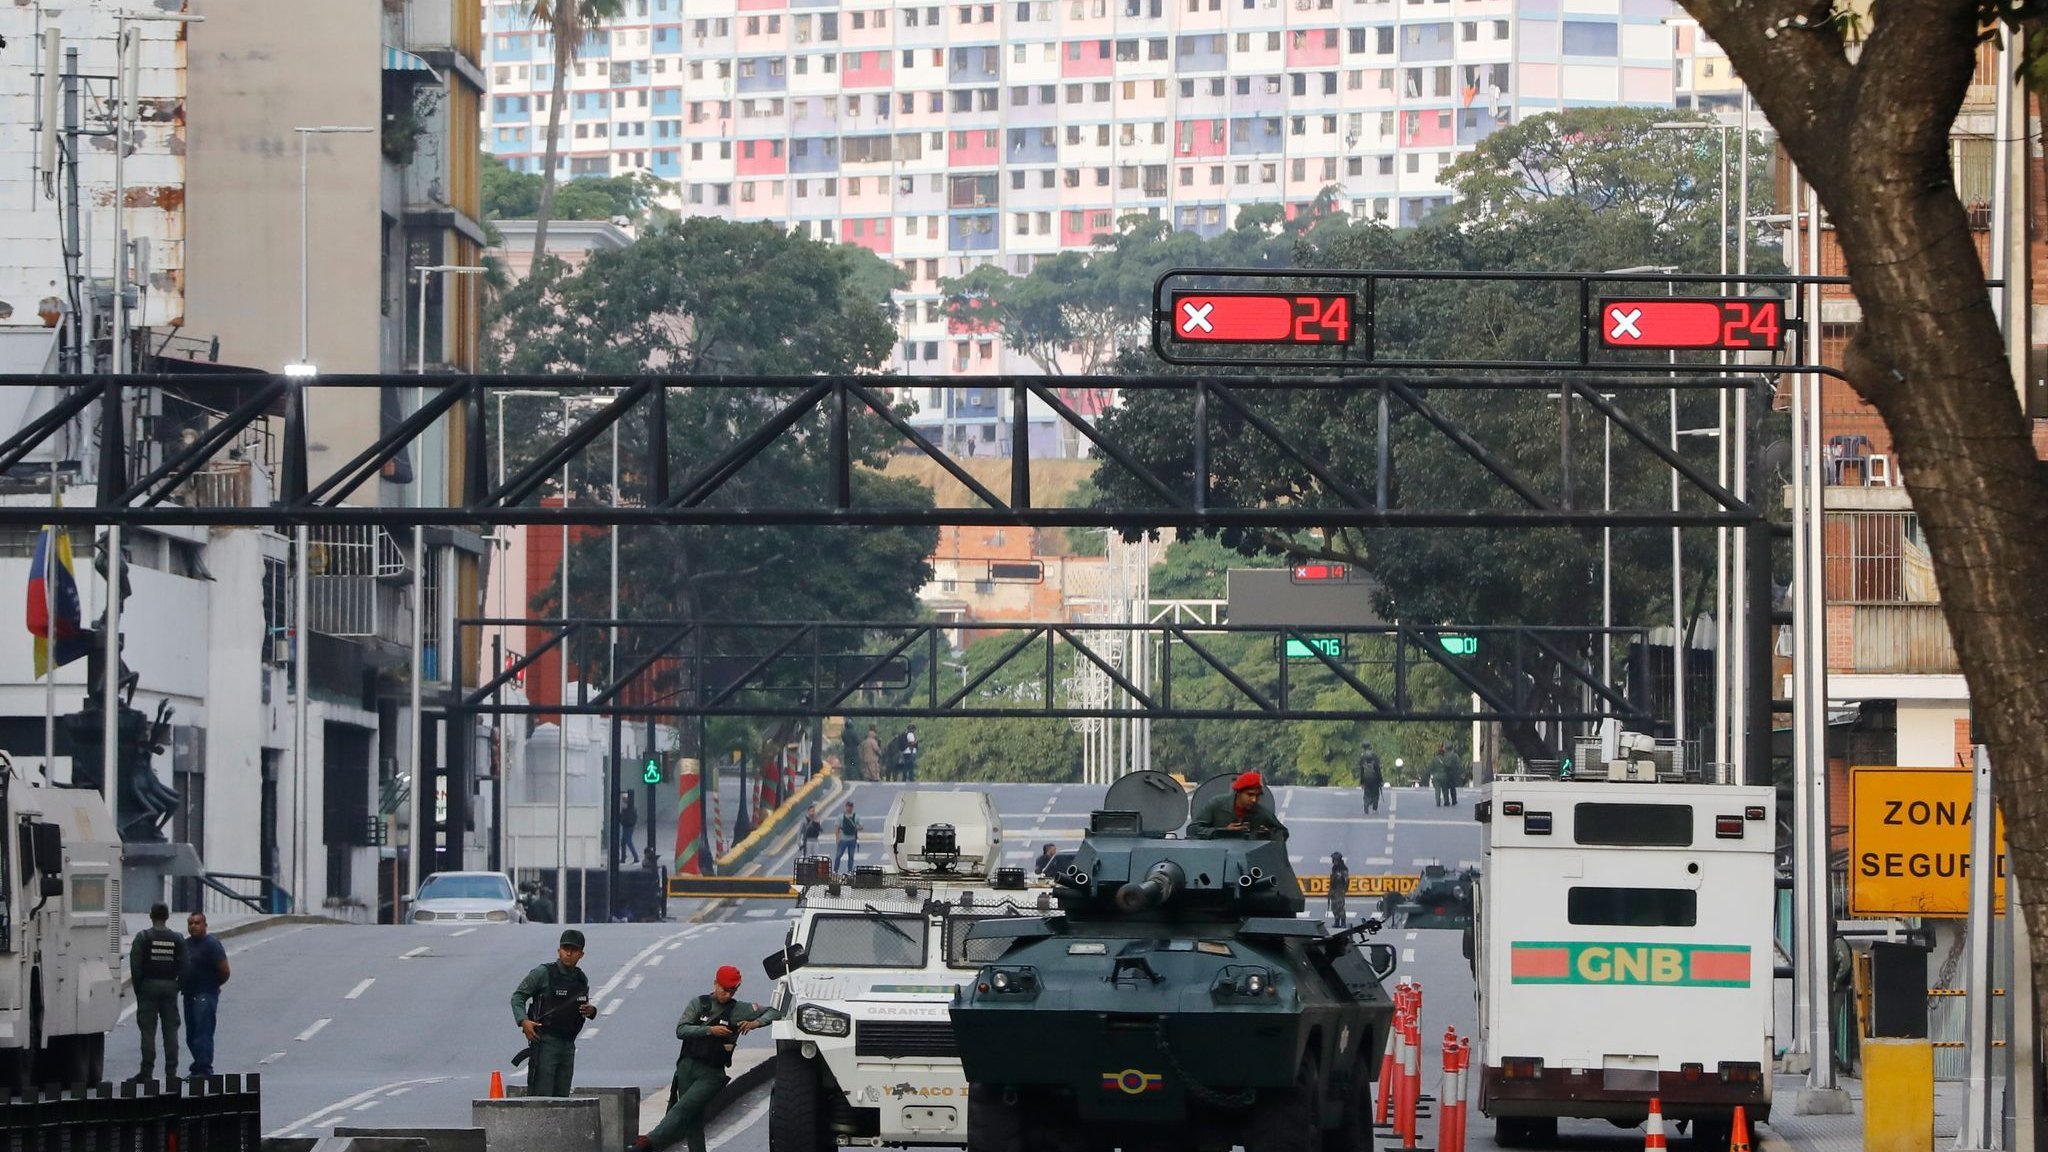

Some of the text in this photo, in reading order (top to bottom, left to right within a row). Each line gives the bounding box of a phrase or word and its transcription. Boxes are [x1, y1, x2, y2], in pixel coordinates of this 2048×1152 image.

[1295, 297, 1349, 341] 24
[1724, 302, 1778, 347] 24
[1577, 946, 1684, 983] GNB
[867, 1006, 937, 1016] GARANTE
